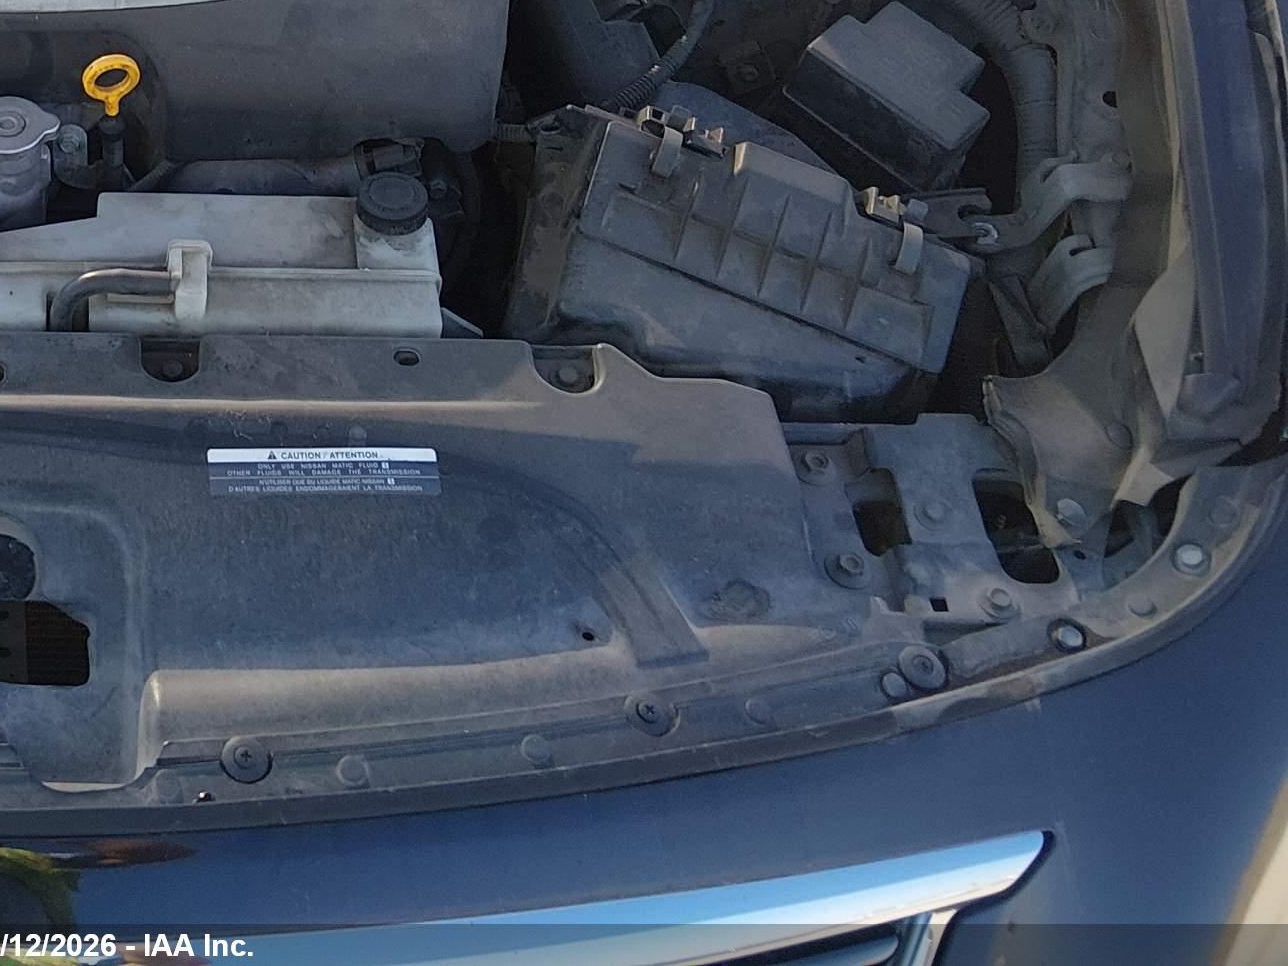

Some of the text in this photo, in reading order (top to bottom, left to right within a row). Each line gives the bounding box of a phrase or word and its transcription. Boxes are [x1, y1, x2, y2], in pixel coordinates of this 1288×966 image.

[281, 452, 321, 460] CAUTION
[329, 451, 378, 459] ATTENTION
[300, 462, 327, 470] NISSAN
